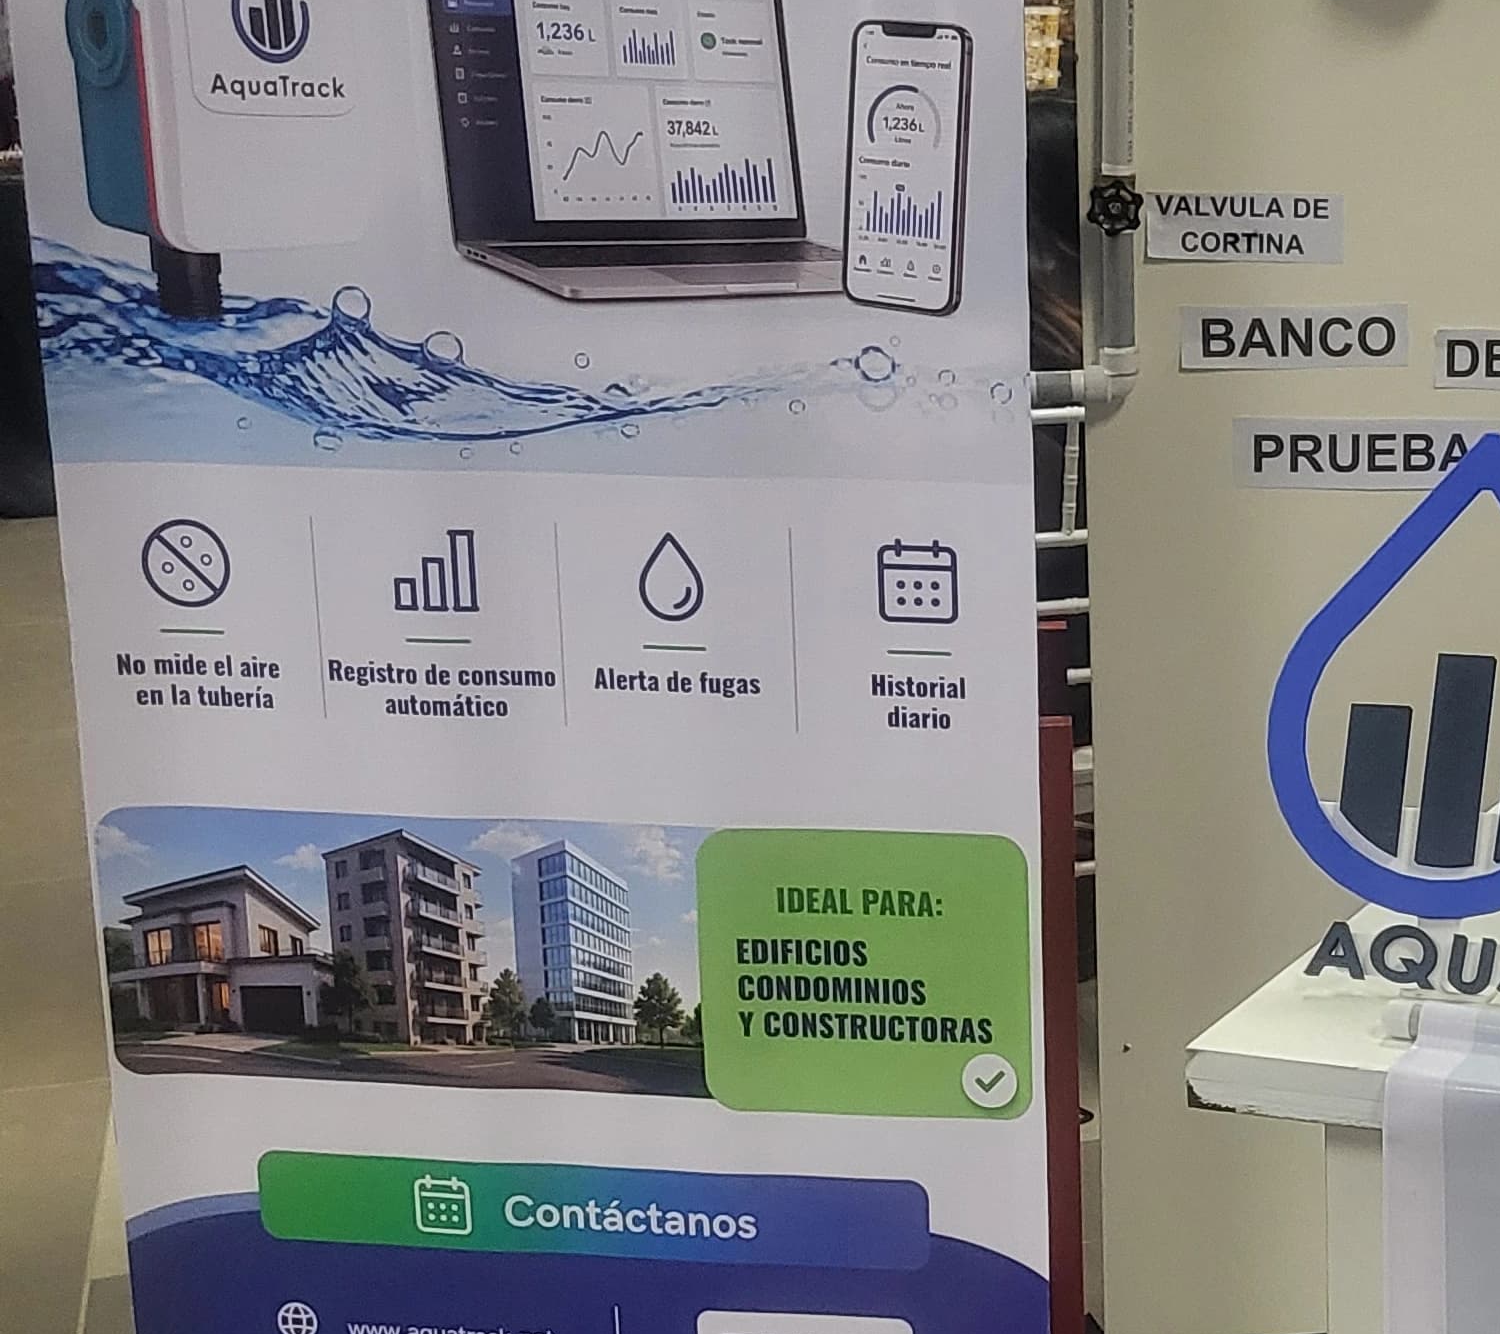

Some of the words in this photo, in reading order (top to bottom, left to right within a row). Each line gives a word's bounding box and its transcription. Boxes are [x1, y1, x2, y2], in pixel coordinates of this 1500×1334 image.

[536, 22, 585, 42] 1,236
[210, 73, 345, 100] AquaTrack
[667, 120, 711, 137] 37,842
[1155, 194, 1284, 219] VALVULA
[1293, 198, 1329, 219] DE
[1181, 232, 1304, 255] CORTINA
[1202, 317, 1396, 357] BANCO
[117, 653, 145, 676] No
[153, 654, 205, 678] mide
[213, 654, 232, 679] el
[239, 656, 281, 680] aire
[328, 658, 416, 692] Registro
[424, 663, 451, 688] de
[457, 669, 556, 690] consumo
[136, 685, 162, 707] en
[170, 681, 190, 709] la
[197, 683, 274, 710] tubería
[594, 668, 655, 695] Alerta
[664, 670, 691, 695] de
[699, 670, 761, 700] fugas
[871, 674, 967, 701] Historial
[385, 692, 508, 719] automático
[887, 704, 951, 731] diario
[776, 887, 853, 915] IDEAL
[862, 889, 943, 917] PARA:
[736, 938, 868, 967] EDIFICIOS
[738, 974, 926, 1006] CONDOMINIOS
[738, 1011, 755, 1036] Y
[764, 1012, 993, 1044] CONSTRUCTORAS
[504, 1193, 758, 1241] Contáctanos
